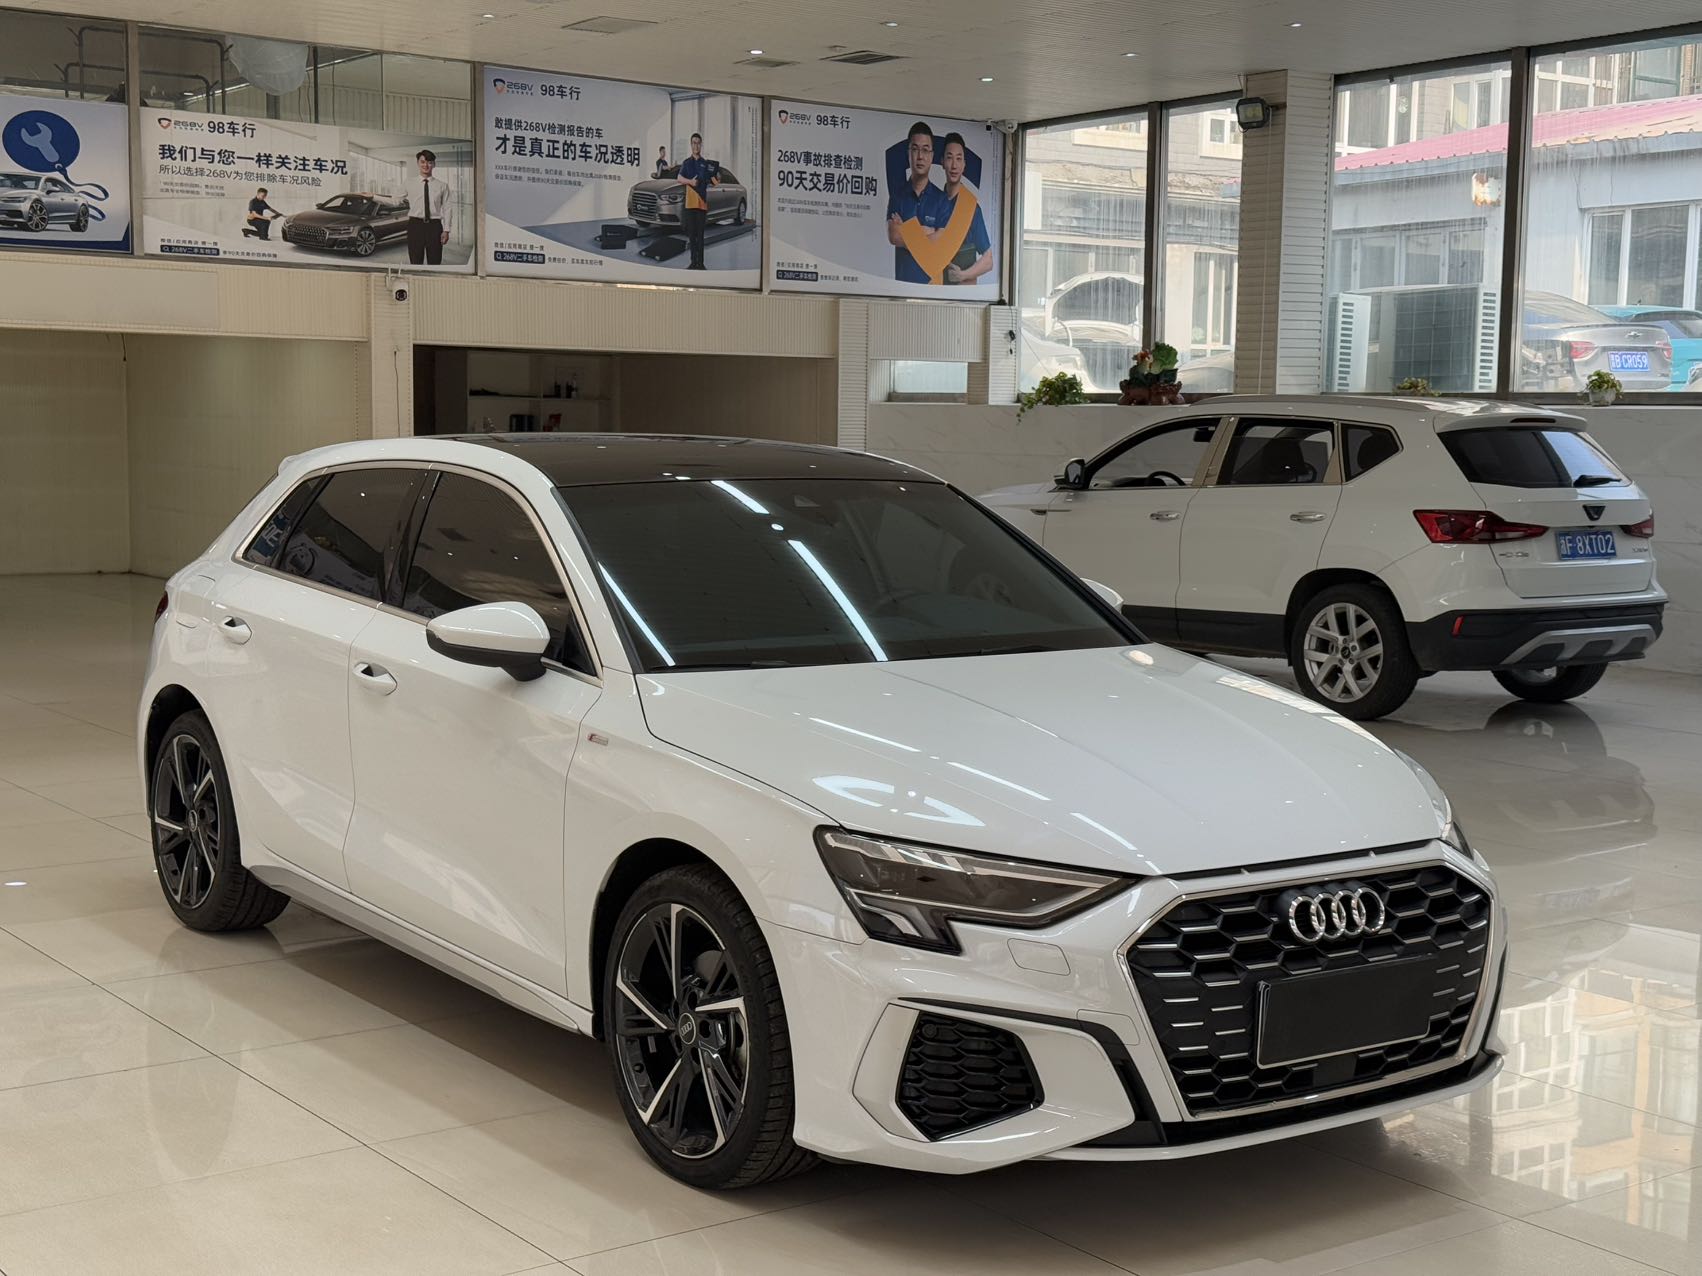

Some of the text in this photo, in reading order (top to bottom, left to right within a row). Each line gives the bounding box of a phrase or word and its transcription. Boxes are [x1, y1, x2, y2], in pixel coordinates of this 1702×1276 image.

[506, 81, 534, 91] 268V
[540, 84, 581, 100] 98车行
[207, 120, 256, 138] 98车行
[495, 116, 604, 139] 敢提供268V检测报告的车
[789, 113, 811, 121] 268V
[816, 114, 850, 130] 98车行
[158, 144, 348, 176] 我们与您一样关注车况
[495, 134, 641, 167] 才是真正的车况透明
[778, 150, 863, 172] 268V事故排查检测
[158, 164, 322, 187] 所以选择268V为您排除车况风险
[778, 170, 878, 196] 90天交易价回购
